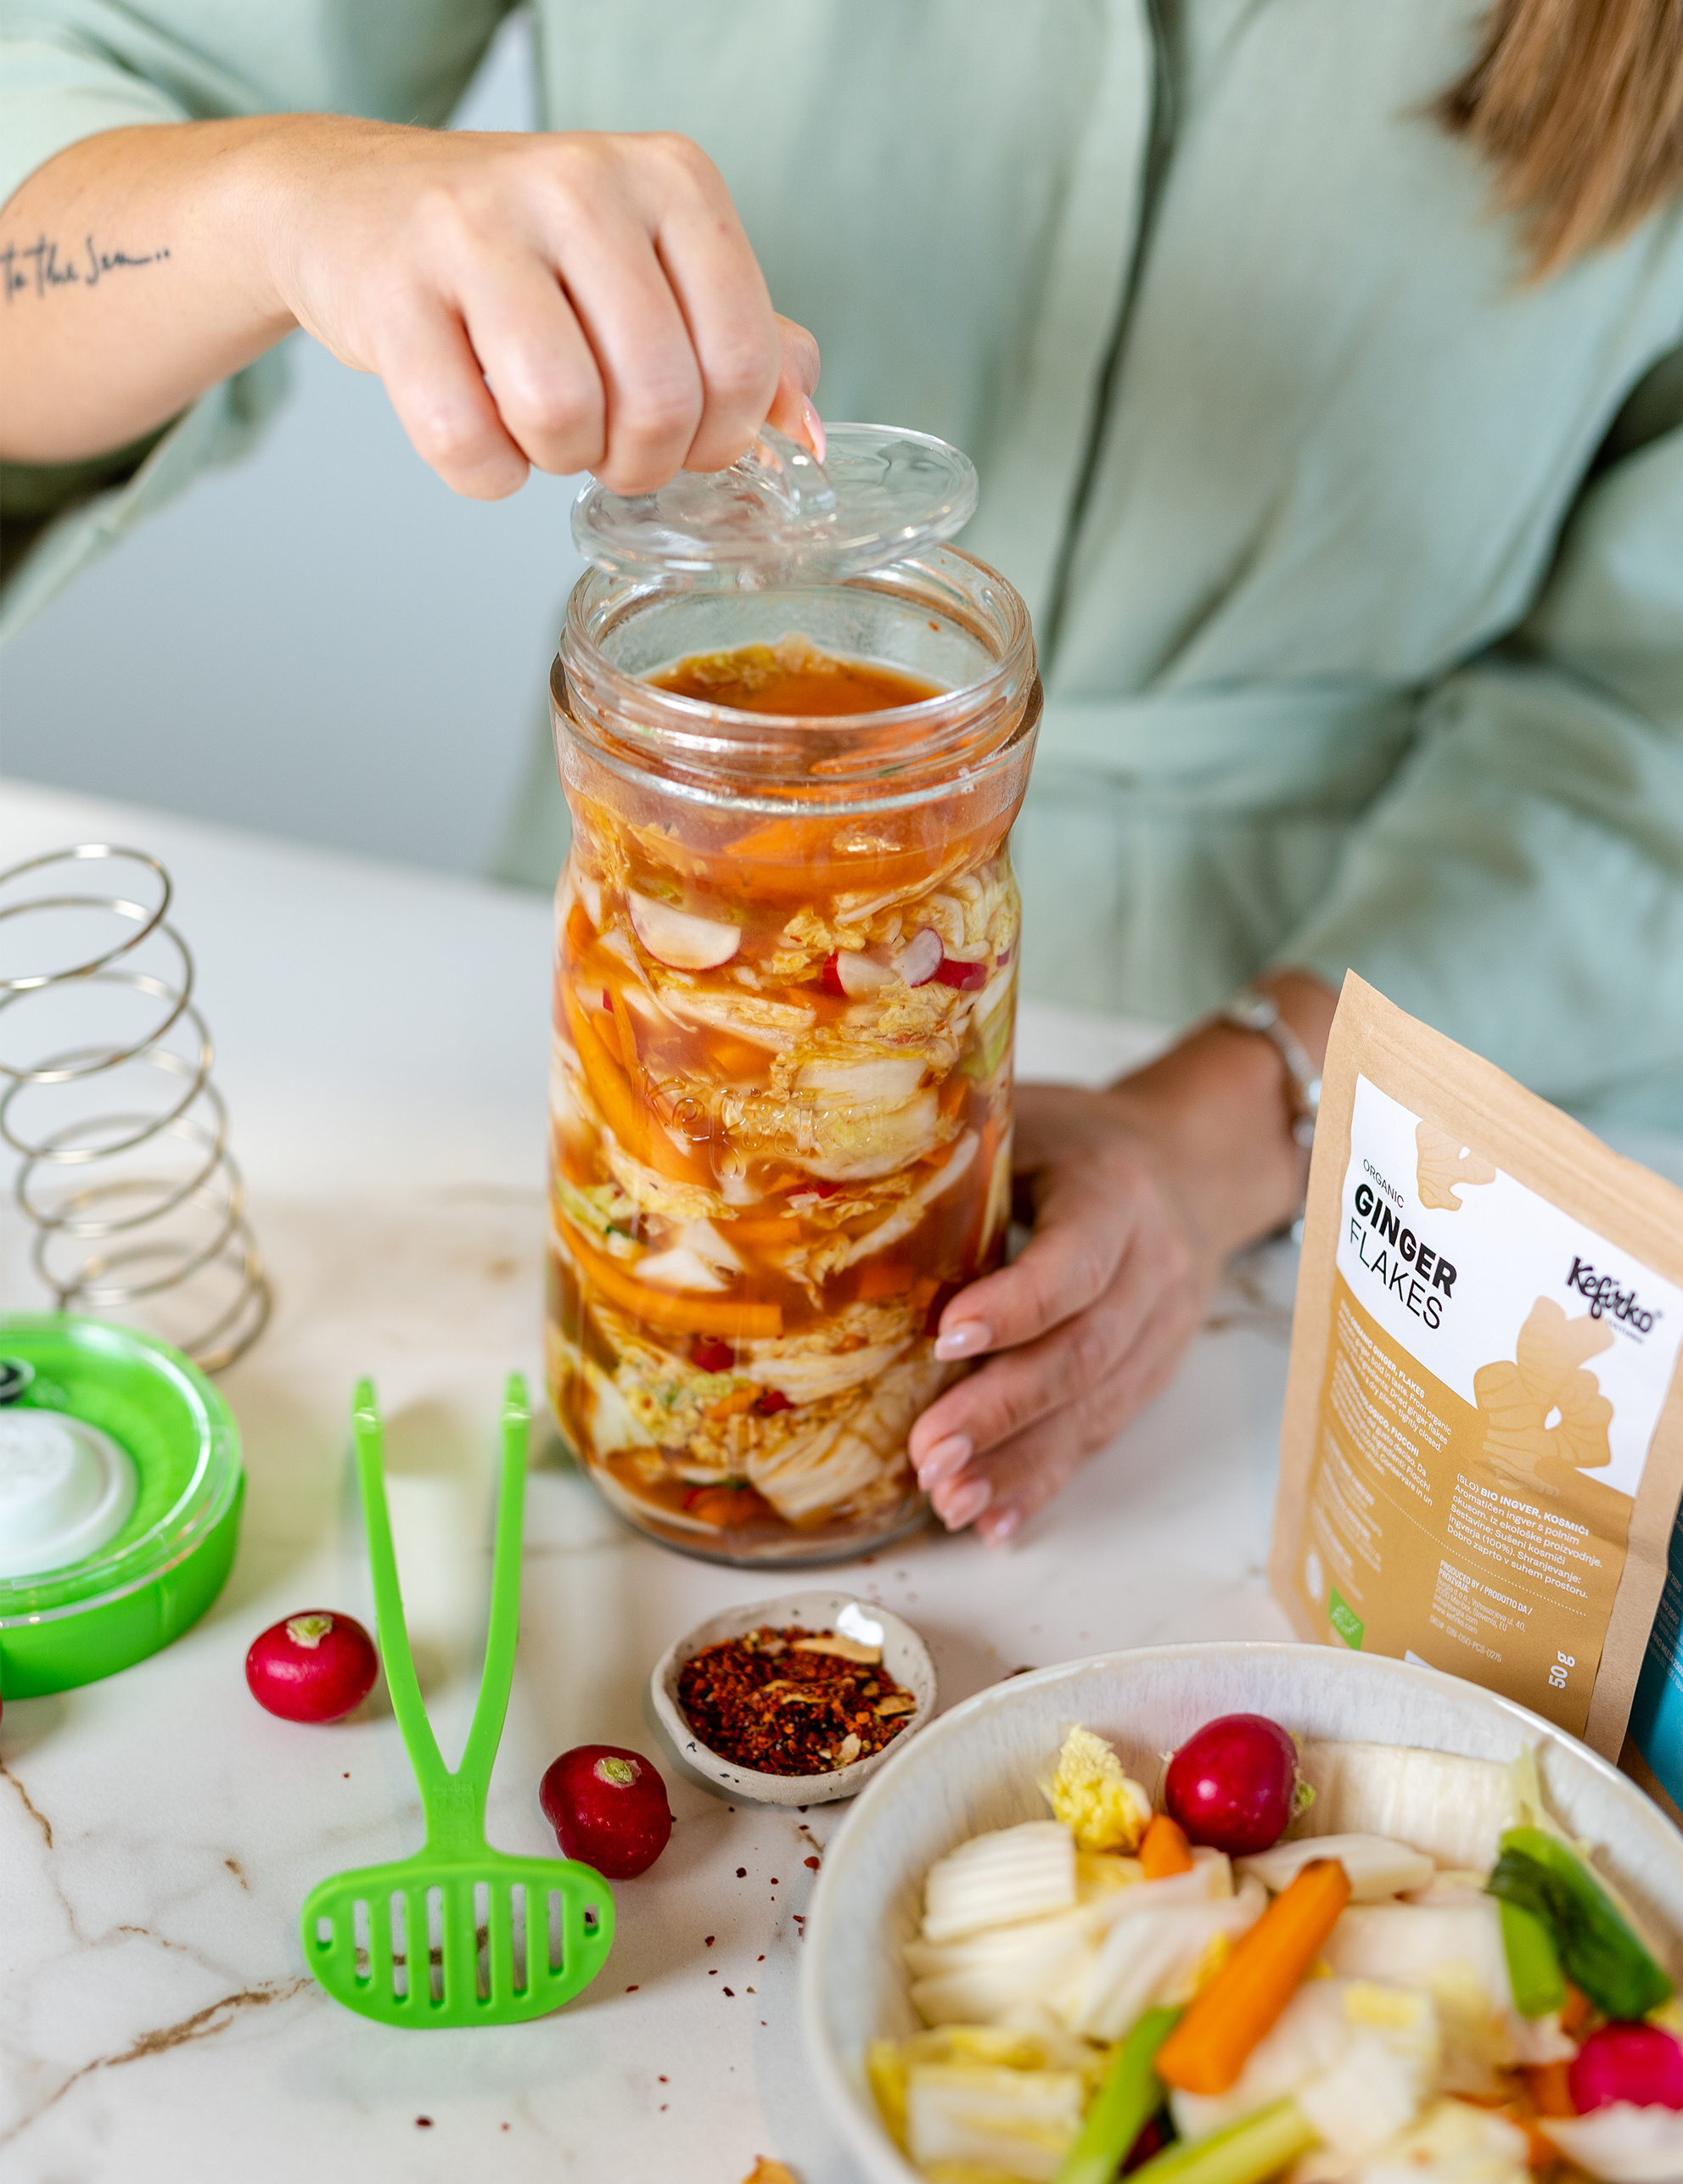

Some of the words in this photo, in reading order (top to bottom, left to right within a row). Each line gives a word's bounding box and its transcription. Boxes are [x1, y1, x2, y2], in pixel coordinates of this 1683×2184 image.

[1362, 1158, 1405, 1208] ORGANIC
[1355, 1183, 1457, 1299] GINGER
[1349, 1216, 1443, 1330] FLAKES
[1371, 1355, 1385, 1374] bold
[1384, 1368, 1391, 1380] in
[1391, 1375, 1409, 1398] taste.
[1409, 1392, 1428, 1414] From
[1428, 1410, 1452, 1436] organic
[1372, 1345, 1399, 1376] GINGER,
[1398, 1369, 1425, 1398] FLAKES
[1368, 1380, 1380, 1397] dry
[1378, 1391, 1398, 1414] place,
[1398, 1408, 1419, 1433] tightly
[1418, 1428, 1442, 1453] closed.
[1389, 1387, 1408, 1409] Dried
[1407, 1406, 1428, 1429] ginger
[1428, 1423, 1449, 1446] flakes
[1390, 1425, 1419, 1458] FIOCCHI
[1371, 1433, 1407, 1470] Ingredienti:
[1406, 1464, 1431, 1492] Fiocchi
[1375, 1426, 1394, 1447] gusto
[1394, 1441, 1417, 1468] deciso.
[1417, 1463, 1427, 1477] Da
[1379, 1453, 1416, 1492] Conservare
[1416, 1485, 1423, 1498] in
[1422, 1493, 1433, 1507] un
[1452, 1494, 1489, 1521] okusom.
[1489, 1514, 1498, 1526] Iz
[1499, 1520, 1543, 1543] ekološke
[1543, 1537, 1603, 1569] proizvodnje.
[1454, 1484, 1505, 1517] Aromatičen
[1506, 1509, 1536, 1528] ingver
[1538, 1523, 1544, 1532] s
[1545, 1526, 1580, 1546] polnim
[1456, 1472, 1479, 1493] (SLO)
[1480, 1487, 1498, 1501] BIO
[1500, 1495, 1541, 1520] INGVER,
[1543, 1511, 1590, 1537] KOSMIČI
[1447, 1524, 1473, 1546] Dobro
[1473, 1541, 1502, 1563] zaprto
[1511, 1560, 1543, 1580] suhem
[1544, 1574, 1589, 1599] prostoru.
[1449, 1514, 1481, 1541] Ingverja
[1482, 1535, 1516, 1558] (100%).
[1517, 1550, 1582, 1585] Shranjevanje:
[1450, 1504, 1494, 1535] Sestavine:
[1495, 1527, 1527, 1549] Sušeni
[1528, 1542, 1567, 1565] kosmiči
[1435, 1586, 1450, 1602] 2000
[1473, 1607, 1498, 1630] Slovenia,
[1499, 1621, 1507, 1632] EU
[1438, 1568, 1470, 1593] PROIZVAJA:
[1439, 1560, 1471, 1586] PRODUCED
[1471, 1578, 1480, 1589] BY
[1484, 1587, 1518, 1609] PRODOTTO
[1518, 1603, 1528, 1615] DA
[1515, 1621, 1526, 1632] 40,
[1548, 1664, 1568, 1689] 50
[1557, 1650, 1576, 1668] g
